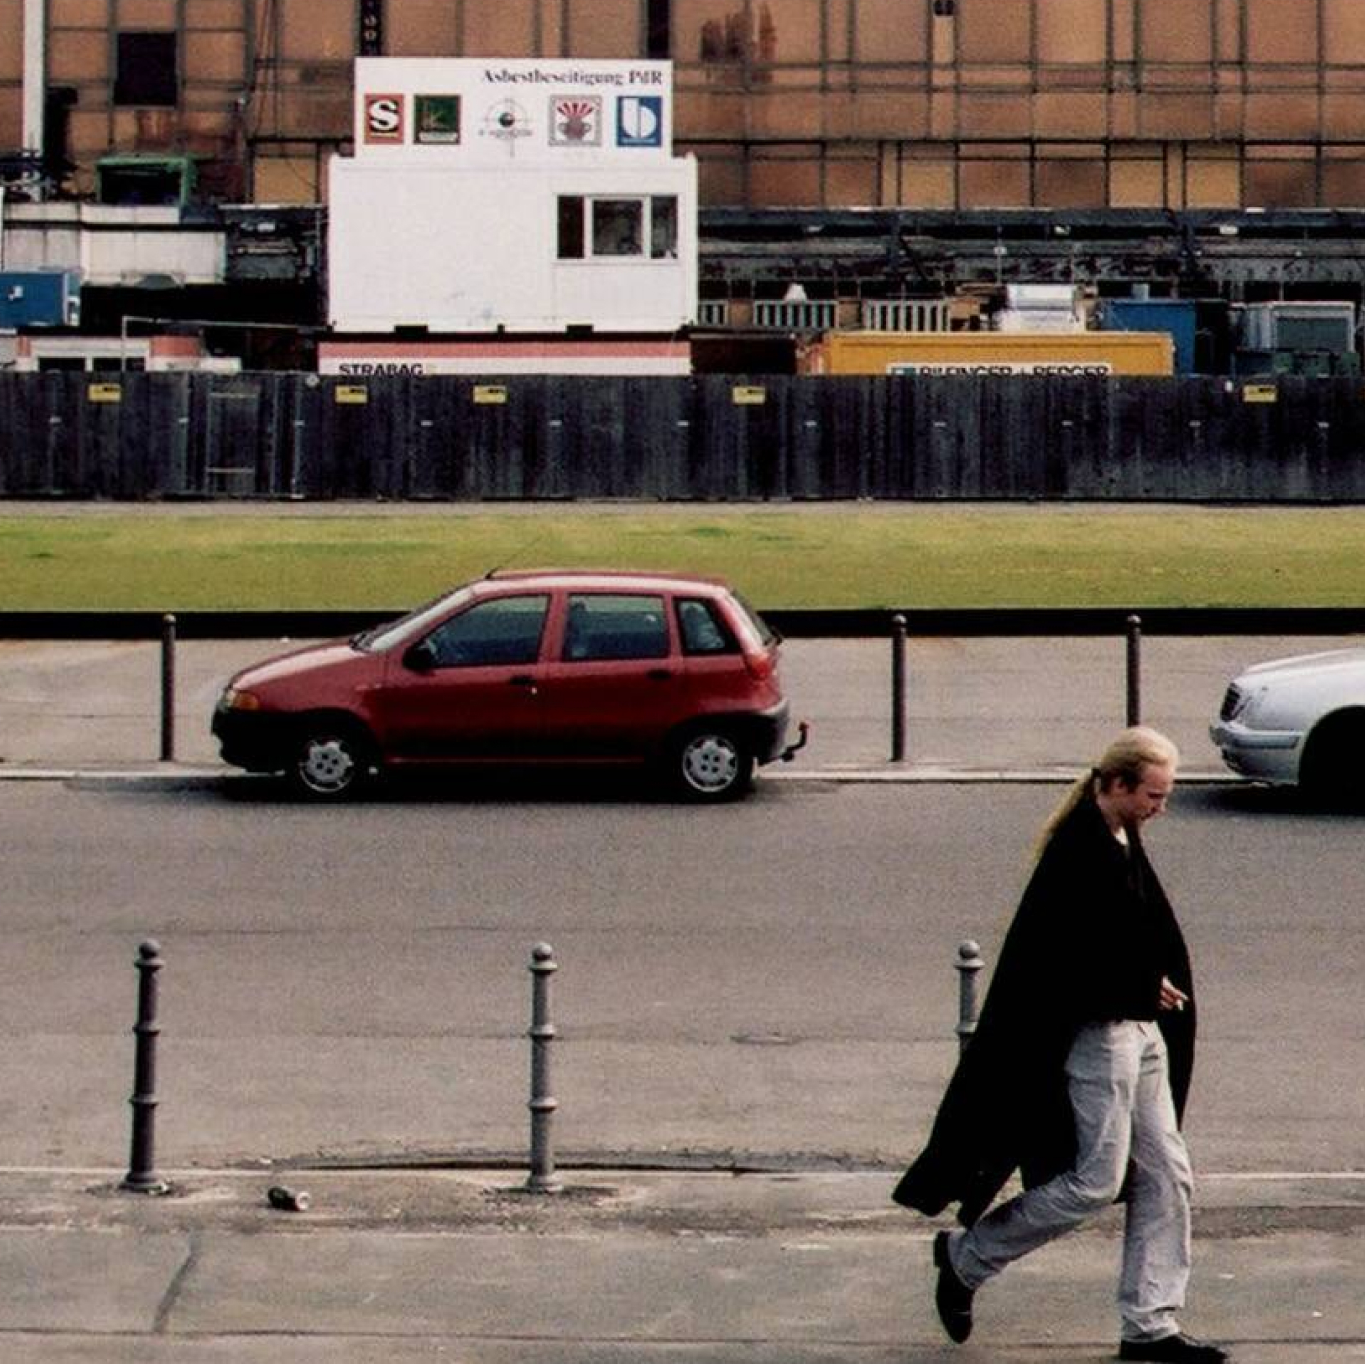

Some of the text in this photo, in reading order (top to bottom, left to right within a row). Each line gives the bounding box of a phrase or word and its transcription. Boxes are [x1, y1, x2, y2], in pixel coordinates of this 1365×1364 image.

[483, 69, 623, 86] Asbestbeseitigung
[368, 99, 400, 131] S
[338, 362, 424, 376] STRABAG
